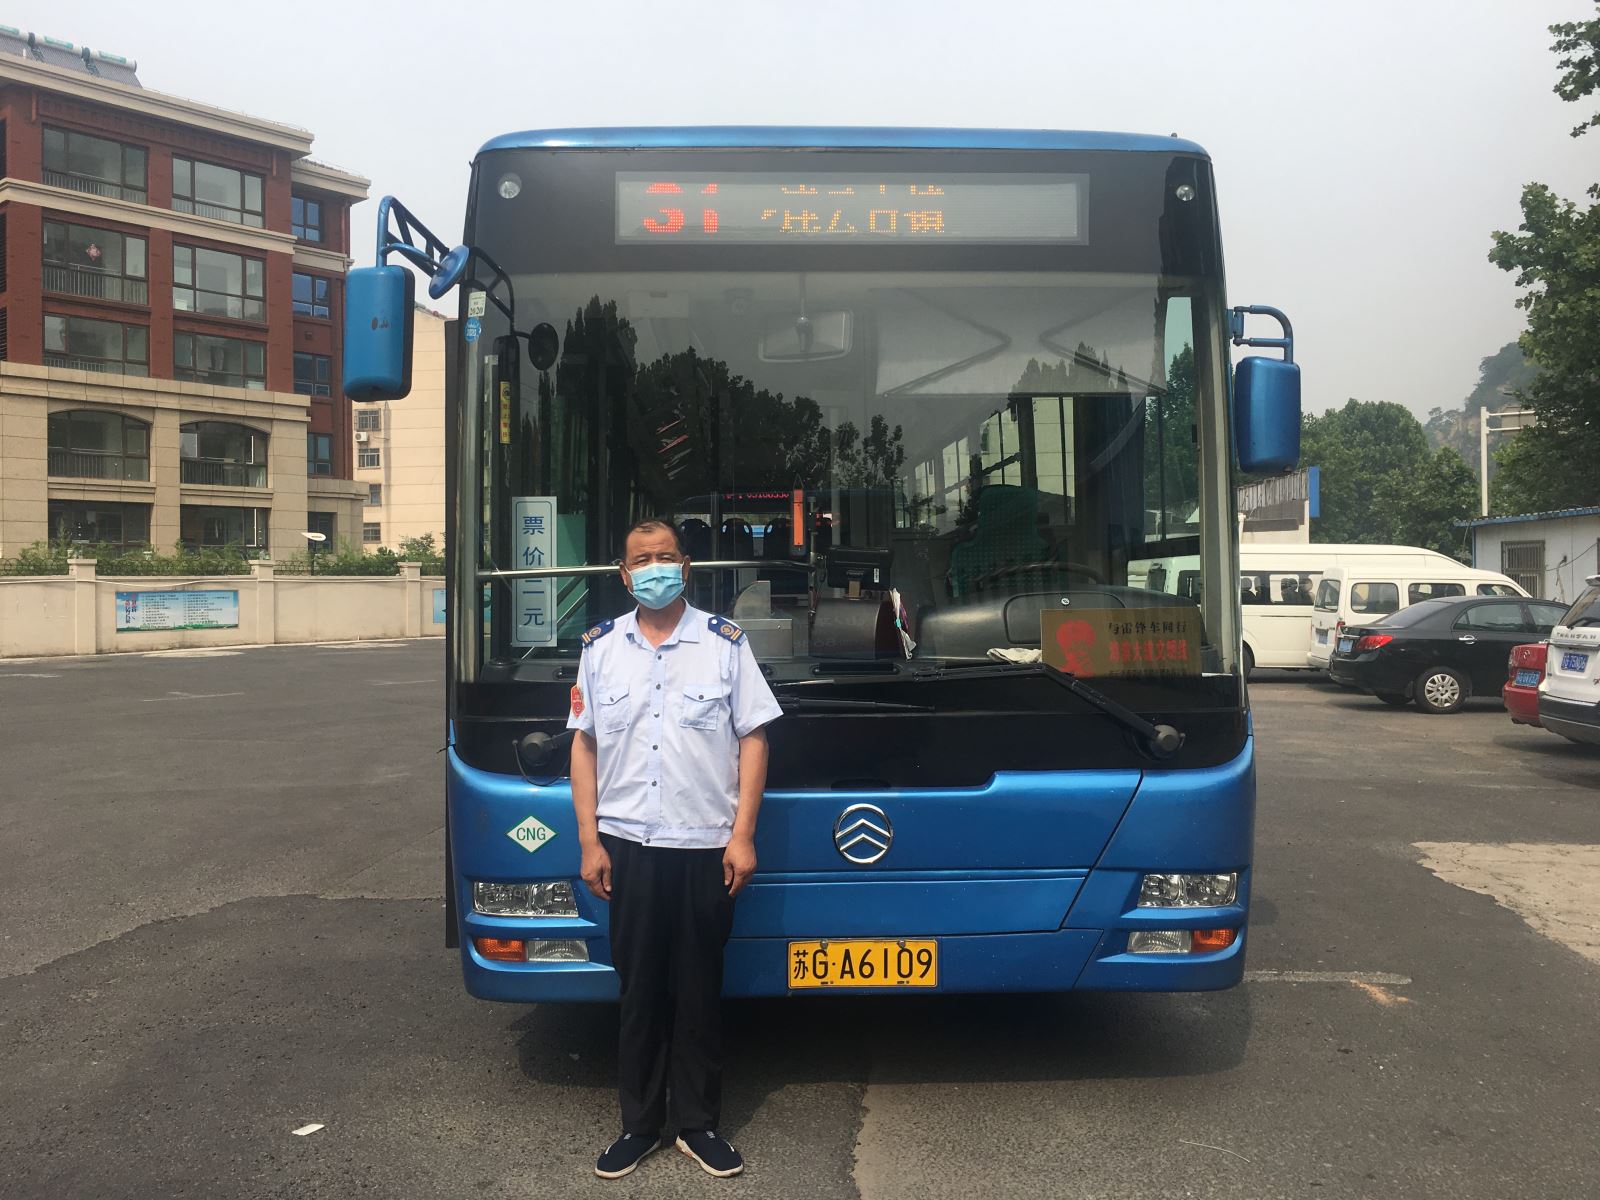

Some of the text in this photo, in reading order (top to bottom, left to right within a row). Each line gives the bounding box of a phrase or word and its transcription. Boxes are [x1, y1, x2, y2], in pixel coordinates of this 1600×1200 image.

[522, 516, 545, 626] 票价二元
[516, 827, 546, 841] CNG
